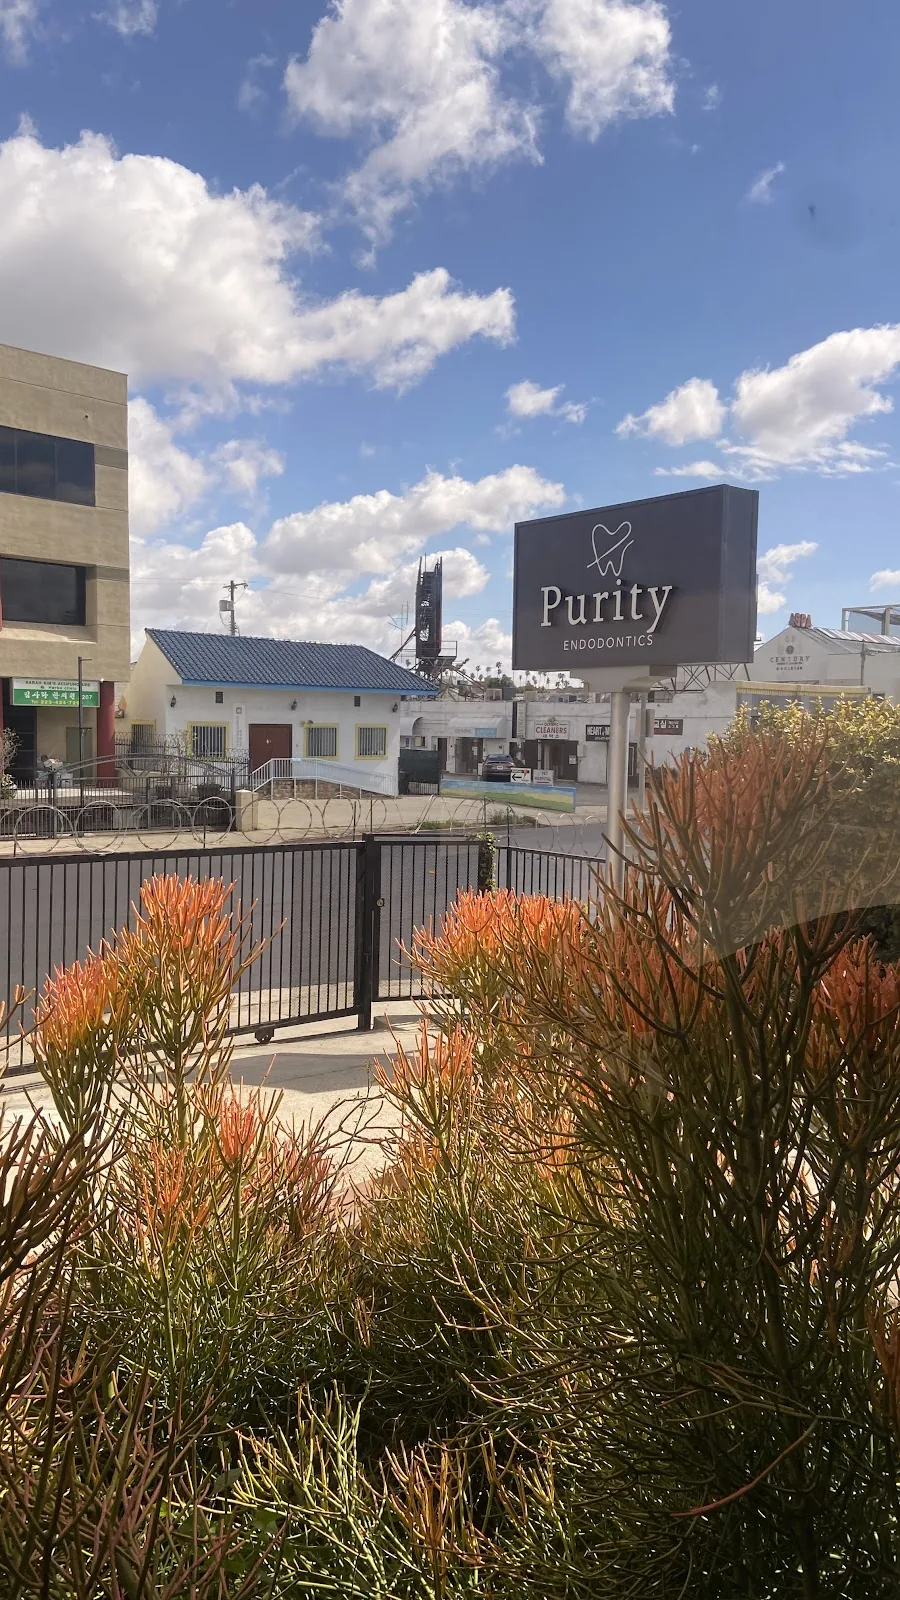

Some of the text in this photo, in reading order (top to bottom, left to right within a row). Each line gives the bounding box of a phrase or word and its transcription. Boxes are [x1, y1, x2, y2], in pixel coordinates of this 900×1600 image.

[540, 578, 673, 633] Purity
[563, 634, 653, 651] ENDODONTICS
[535, 726, 567, 734] CLEANERS
[586, 726, 602, 736] HEART
